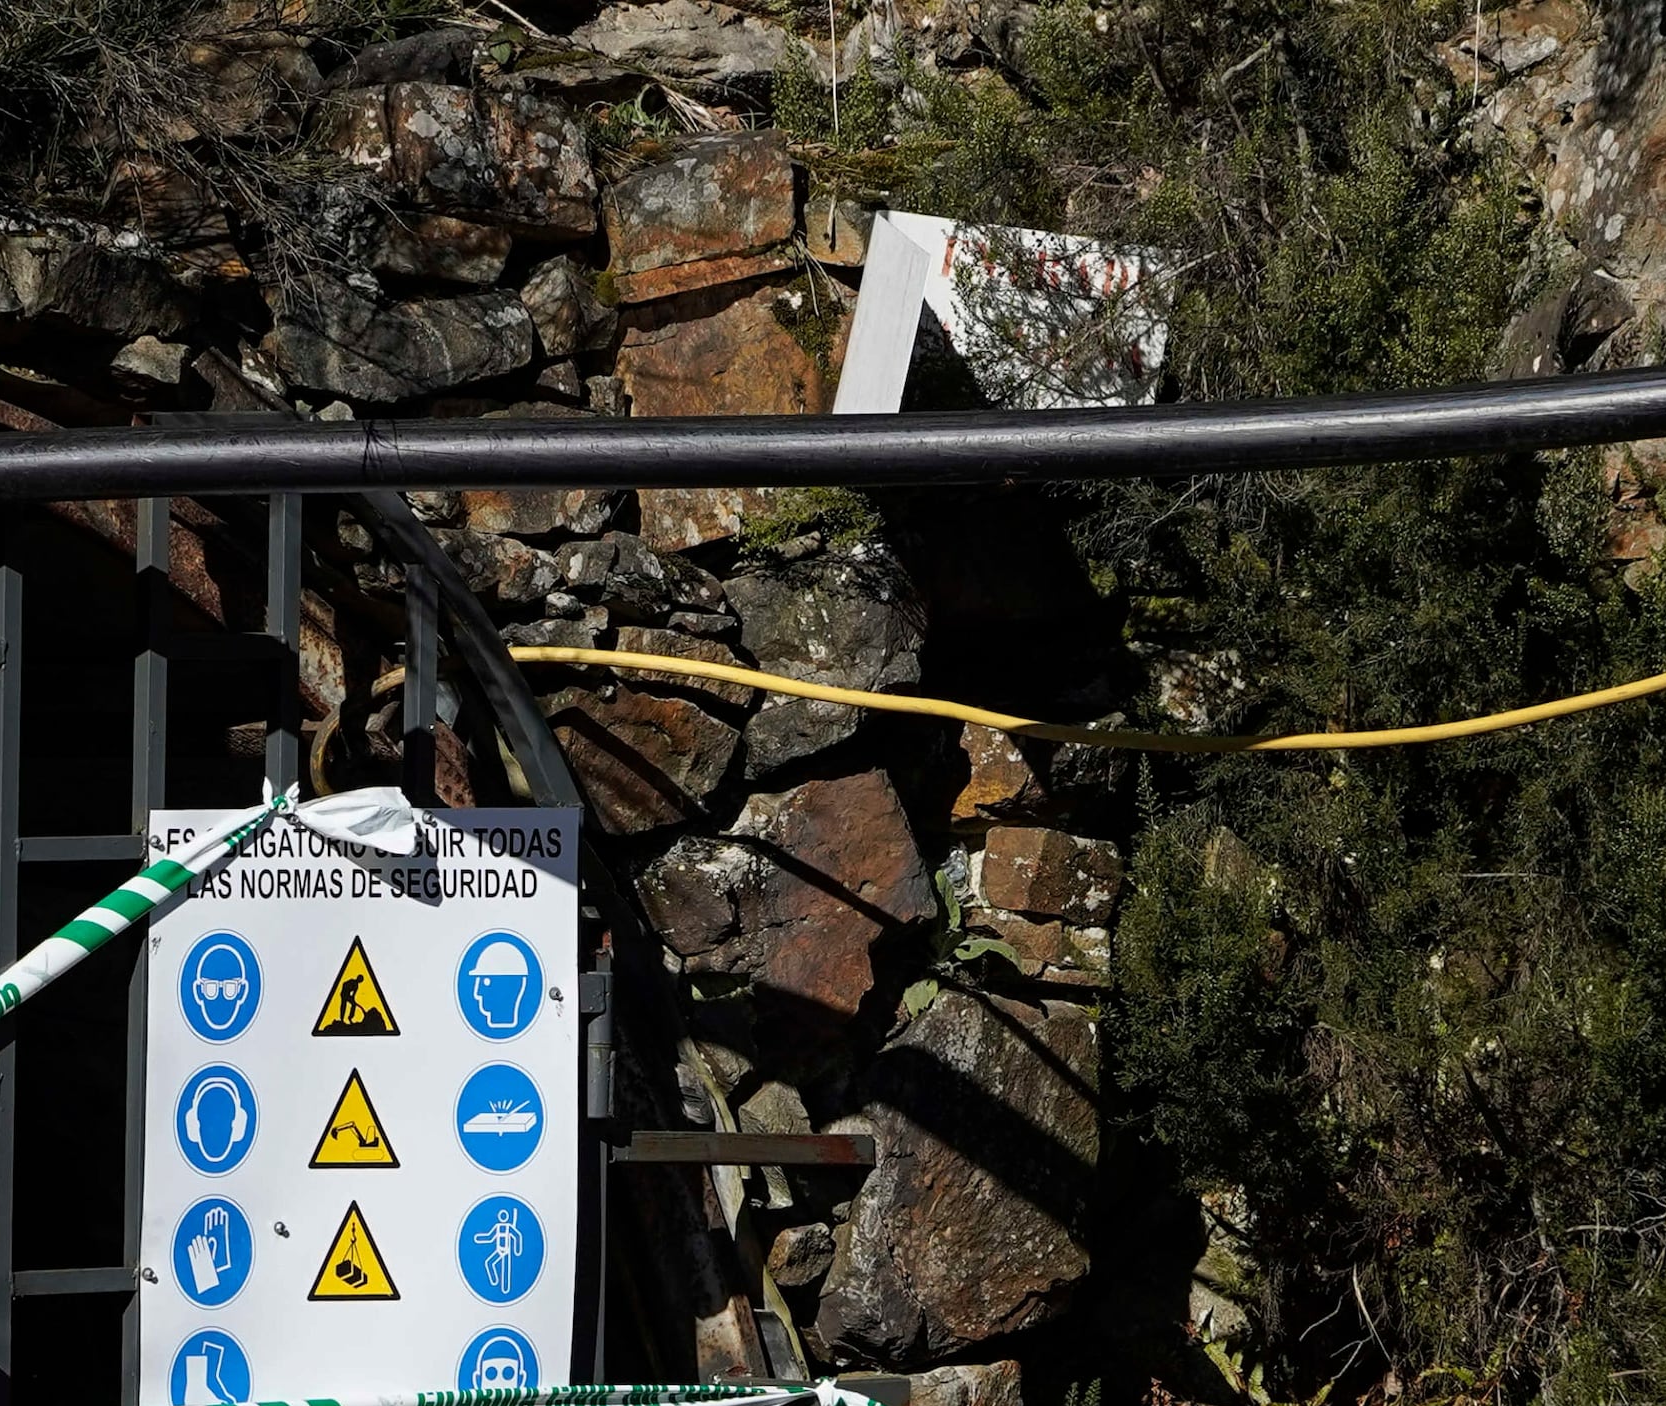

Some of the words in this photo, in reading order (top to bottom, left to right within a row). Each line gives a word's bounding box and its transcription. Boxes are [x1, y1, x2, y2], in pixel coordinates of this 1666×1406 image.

[473, 827, 563, 858] TODAS
[187, 868, 232, 899] LAS
[241, 868, 343, 899] NORMAS
[351, 868, 383, 899] DE
[389, 867, 539, 899] SEGURIDAD
